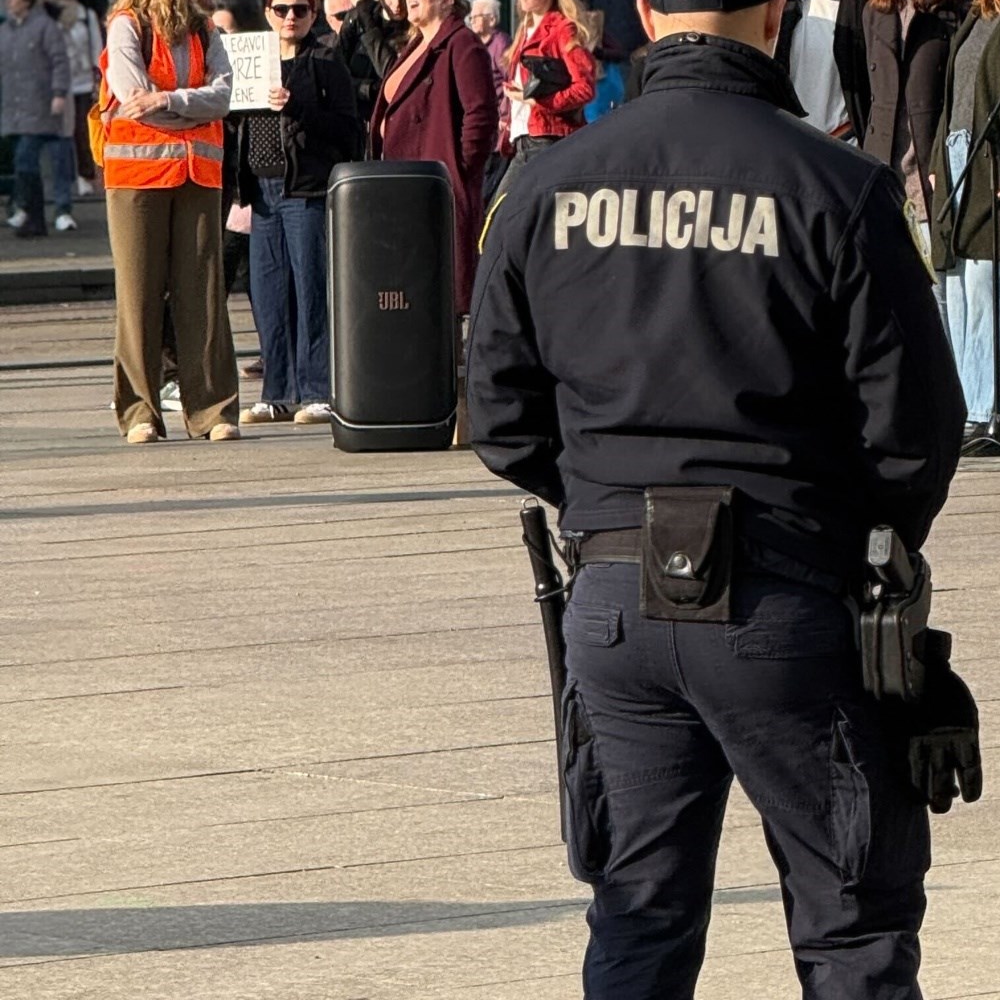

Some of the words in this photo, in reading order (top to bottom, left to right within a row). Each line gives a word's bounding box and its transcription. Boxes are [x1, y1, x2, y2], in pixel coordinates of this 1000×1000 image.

[232, 86, 255, 103] ENE
[554, 188, 780, 257] POLICIJA
[378, 291, 409, 310] JBL
